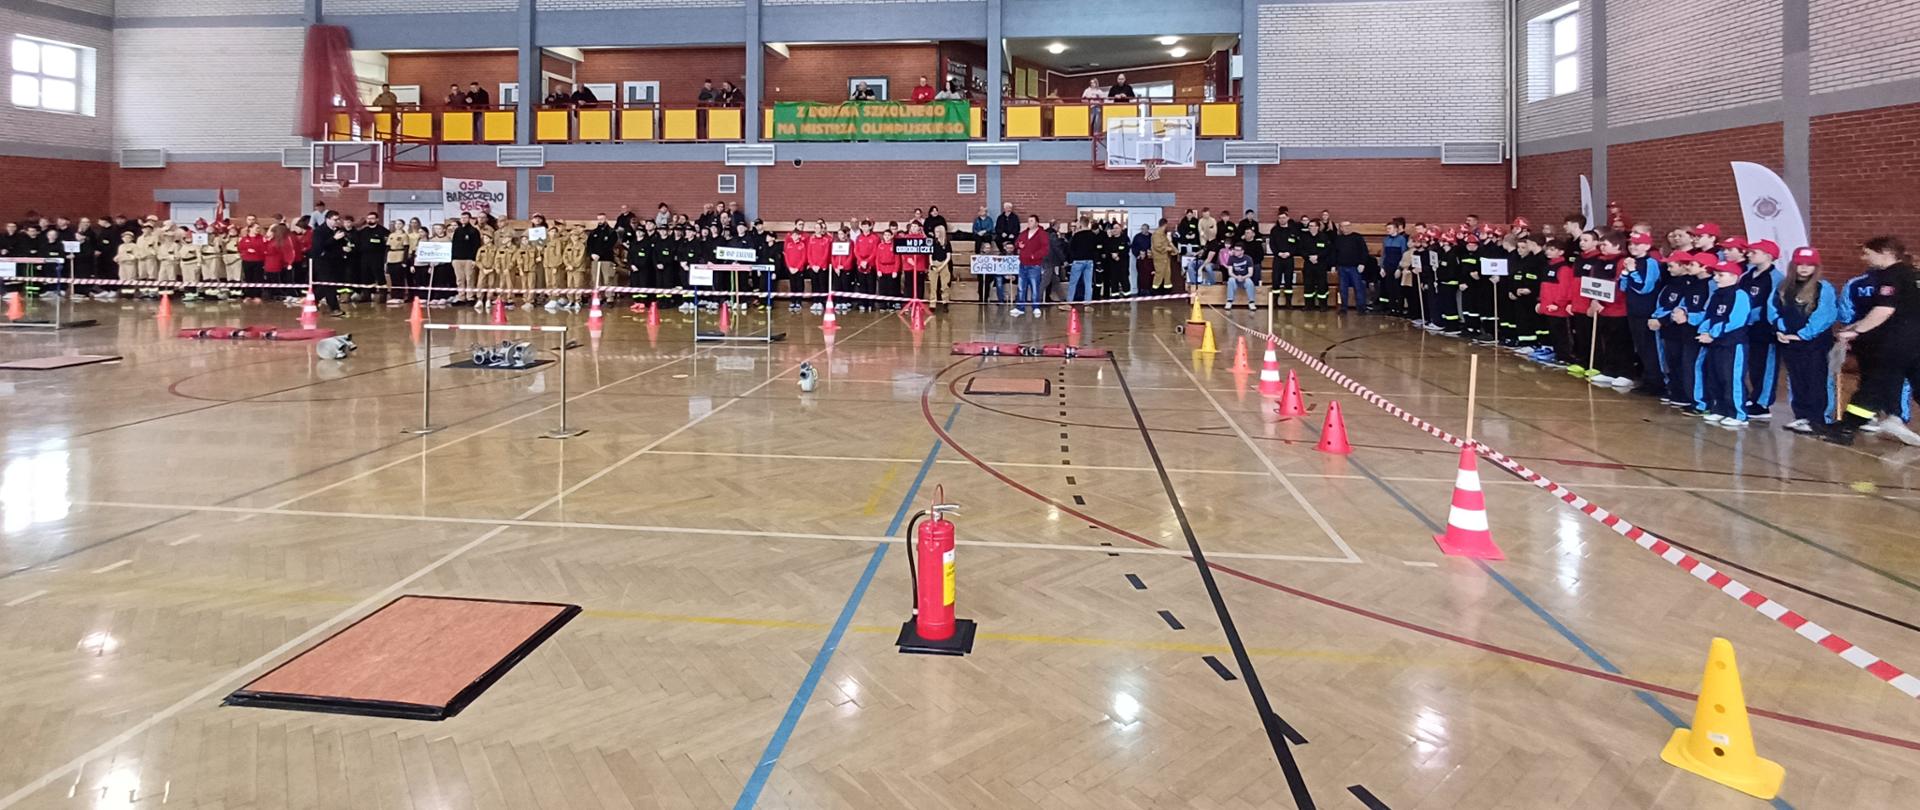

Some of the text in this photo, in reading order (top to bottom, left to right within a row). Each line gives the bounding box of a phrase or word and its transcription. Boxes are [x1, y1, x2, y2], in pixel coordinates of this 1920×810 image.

[797, 104, 806, 118] Z
[863, 104, 945, 117] SZKOLNEGO
[778, 122, 965, 135] NA MISTRZA OLIMPIJSKIEGO
[459, 181, 483, 190] OSP
